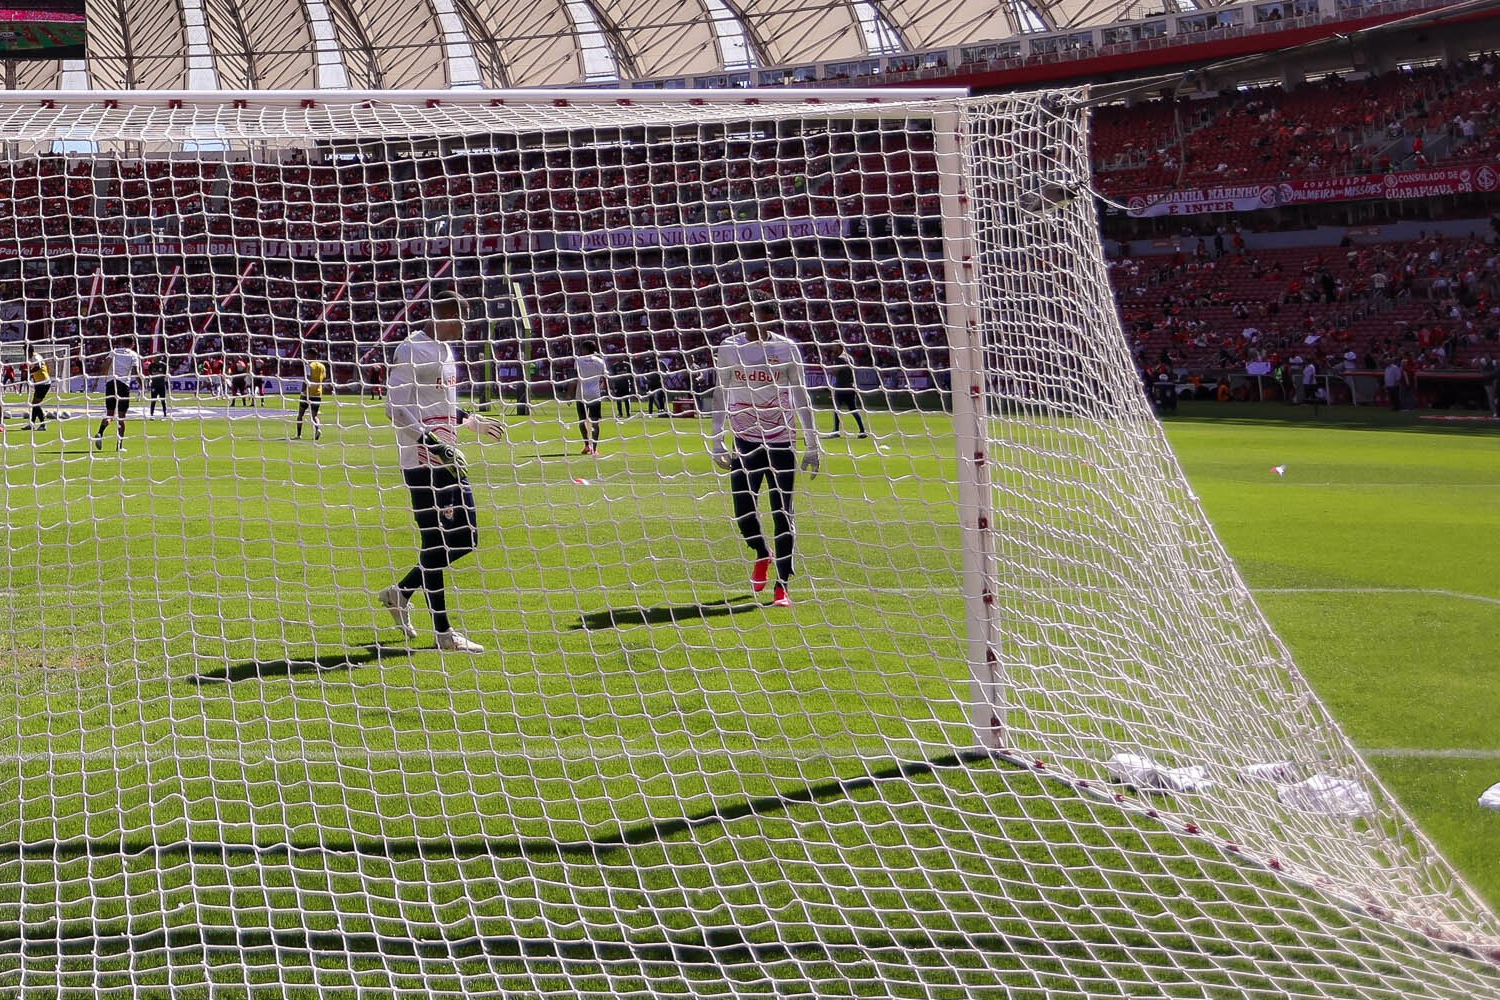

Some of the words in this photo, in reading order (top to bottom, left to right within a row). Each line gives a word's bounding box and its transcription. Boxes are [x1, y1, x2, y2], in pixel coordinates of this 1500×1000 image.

[1185, 201, 1234, 214] INTER
[711, 227, 752, 242] PEO
[761, 223, 808, 240] NTER
